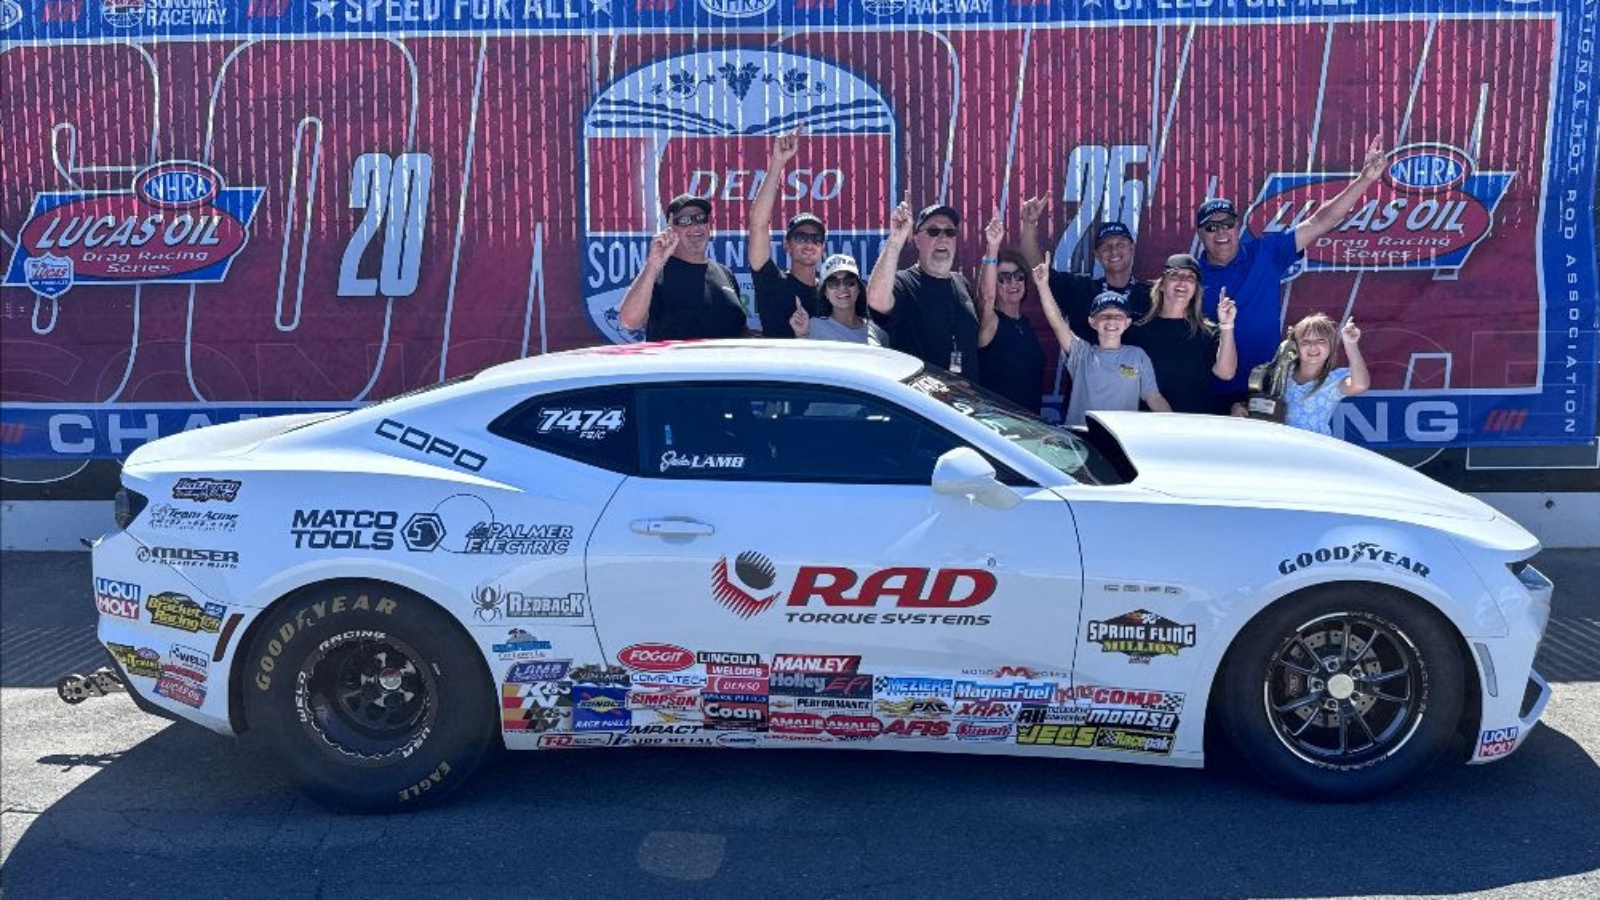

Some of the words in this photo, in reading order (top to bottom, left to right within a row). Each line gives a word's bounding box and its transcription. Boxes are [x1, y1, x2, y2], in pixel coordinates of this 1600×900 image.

[147, 8, 228, 26] RACEWAY
[345, 0, 440, 22] SPEED
[453, 0, 512, 20] FOR
[523, 0, 580, 18] ALL
[1569, 123, 1584, 175] HOT
[1399, 156, 1457, 185] NHRA
[151, 172, 207, 199] NHRA
[1264, 199, 1407, 233] LAS
[1405, 199, 1469, 232] OIL
[1564, 189, 1578, 240] ROD
[36, 213, 165, 249] LUCAS
[163, 213, 223, 247] OIL
[338, 153, 433, 297] 20
[1315, 236, 1368, 249] Drag
[1377, 236, 1451, 248] Racing
[82, 251, 131, 264] Drag
[139, 251, 208, 262] Racing
[1343, 249, 1412, 259] Series
[106, 263, 170, 274] Series
[1564, 253, 1580, 433] ASSOCIATION
[537, 407, 624, 433] 7474
[375, 419, 488, 472] COPO
[691, 454, 745, 468] LAMB
[292, 510, 398, 528] MATCO
[487, 522, 573, 539] PALMER
[291, 530, 394, 550] TOOLS
[466, 538, 569, 555] ELECTRIC
[151, 547, 239, 563] MOSER
[97, 578, 140, 600] LIQUI
[787, 566, 998, 608] RAD
[99, 597, 139, 619] MOLY
[509, 594, 583, 613] REDBACK
[785, 613, 877, 624] TORQUE
[881, 613, 991, 626] SYSTEMS
[319, 630, 387, 651] RACING
[1089, 623, 1145, 640] SPRING
[1150, 626, 1193, 645] FLING
[1103, 640, 1179, 653] MILLION
[629, 650, 684, 662] FOGGIT
[699, 653, 757, 665] LINCOLN
[773, 656, 850, 672] MANLEY
[631, 673, 707, 685] COMPUTECH
[712, 666, 763, 676] WELDERS
[723, 681, 760, 690] DENSO
[770, 672, 826, 693] Holley
[888, 680, 952, 692] MEZIERE
[295, 671, 308, 722] WELD
[516, 682, 572, 709] K&N
[631, 693, 697, 706] SIMPSON
[797, 698, 870, 709] PERFORMANCE
[1094, 688, 1162, 706] COMP
[704, 702, 762, 720] Coan
[955, 702, 1005, 717] XRP
[1088, 709, 1175, 728] MOROSO
[625, 726, 704, 735] IMPACT
[770, 717, 825, 728] AMALIE
[827, 722, 880, 732] AMALIE
[402, 727, 430, 758] USA
[1018, 725, 1097, 745] JEGS
[1114, 731, 1172, 750] Racepak
[1483, 728, 1517, 744] LIQUI
[1481, 741, 1515, 757] MOLY
[399, 761, 451, 801] EAGLE
